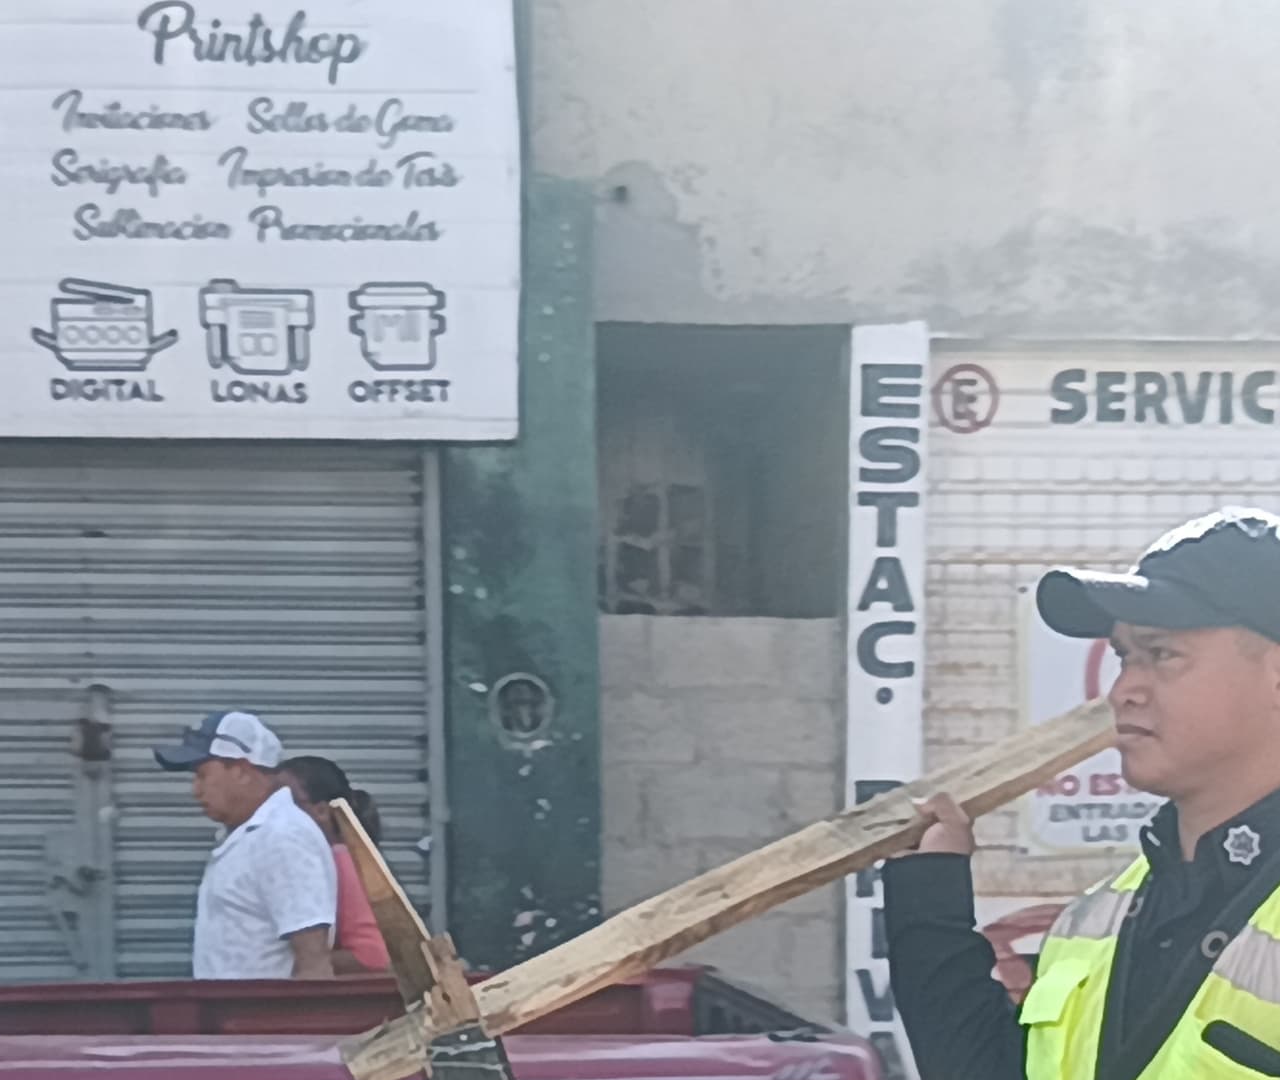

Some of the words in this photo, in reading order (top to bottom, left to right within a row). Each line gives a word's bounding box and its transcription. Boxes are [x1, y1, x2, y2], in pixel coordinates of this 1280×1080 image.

[138, 0, 362, 85] Printshop
[333, 103, 372, 132] de
[355, 159, 393, 187] de
[50, 379, 164, 401] DIGITAL
[210, 380, 308, 403] LONAS
[348, 380, 451, 402] OFFSET
[856, 363, 922, 705] ESTAC.
